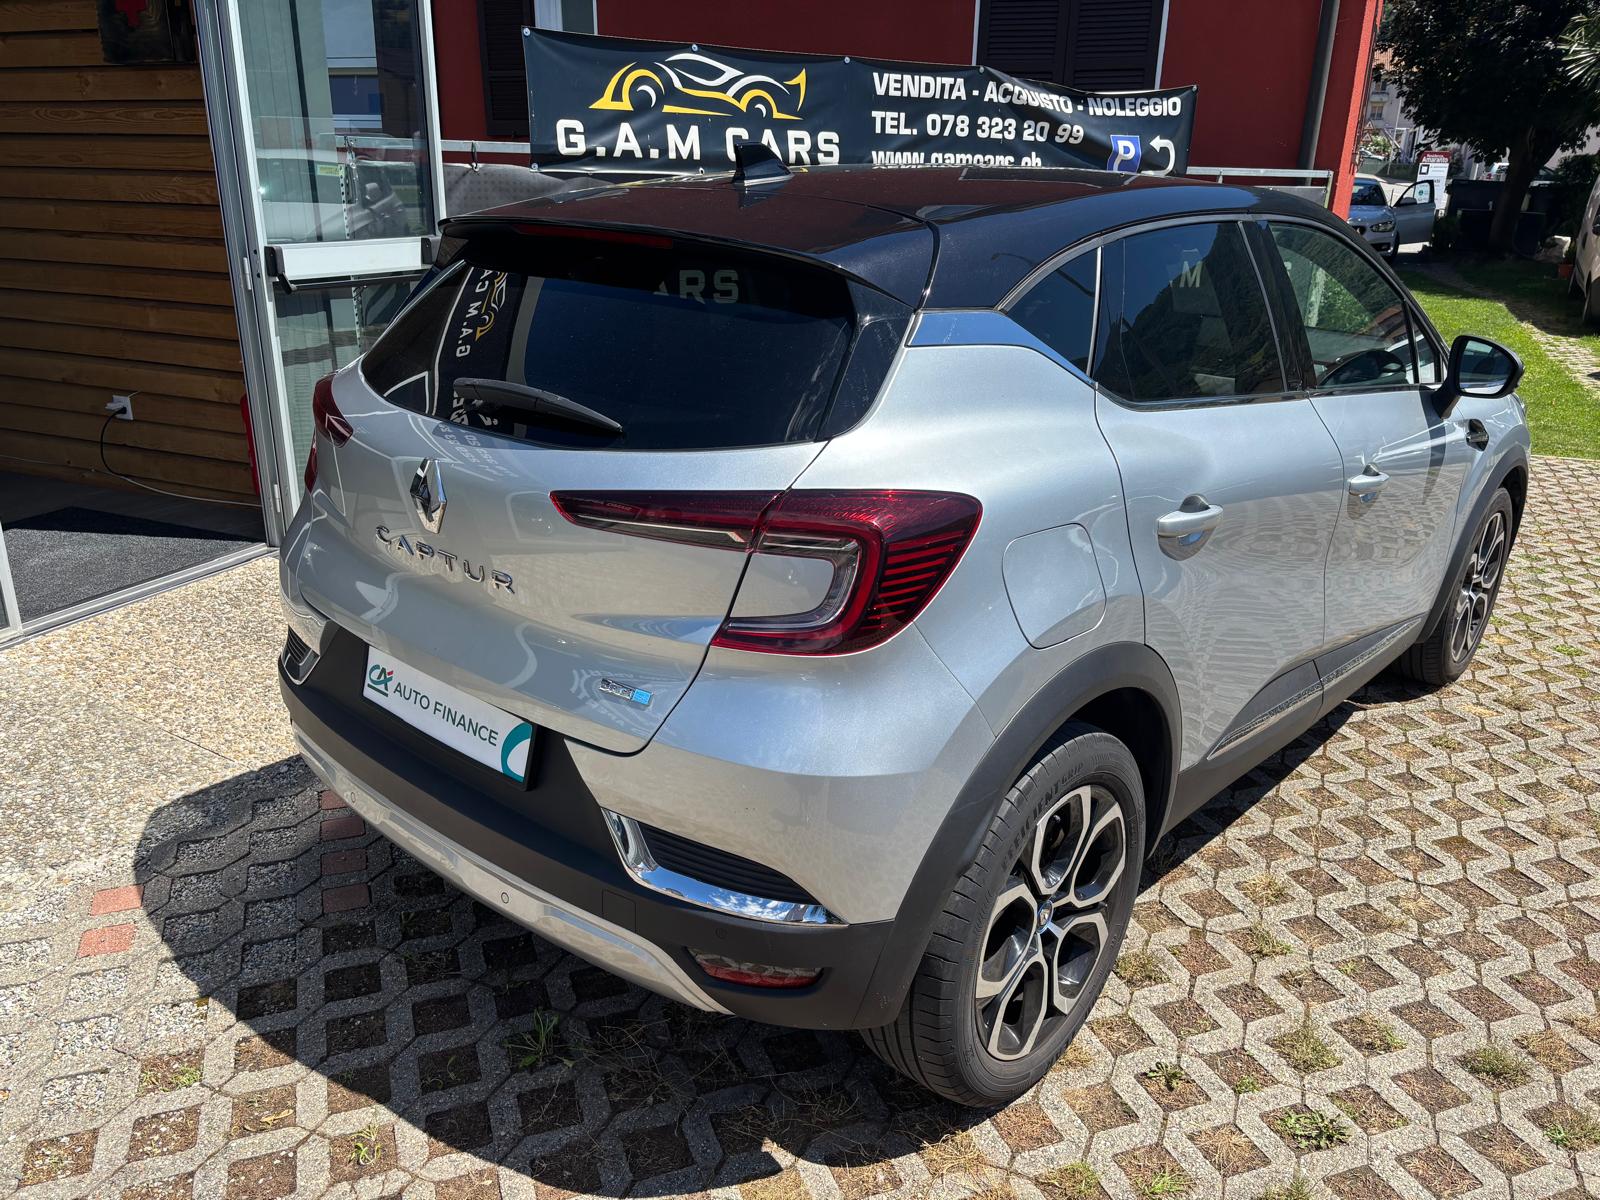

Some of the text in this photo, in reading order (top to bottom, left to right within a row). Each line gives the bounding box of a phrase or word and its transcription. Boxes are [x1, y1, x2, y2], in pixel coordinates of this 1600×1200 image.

[872, 72, 967, 101] VENDITA
[984, 81, 1073, 114] ACQUISTO
[1087, 97, 1181, 117] NOLEGGIO
[555, 118, 840, 166] G.A.M CARS
[871, 110, 1085, 145] TEL. 078 323 20 99
[375, 525, 515, 595] CAPTUR
[393, 682, 431, 712] AUTO
[433, 701, 499, 747] FINANCE
